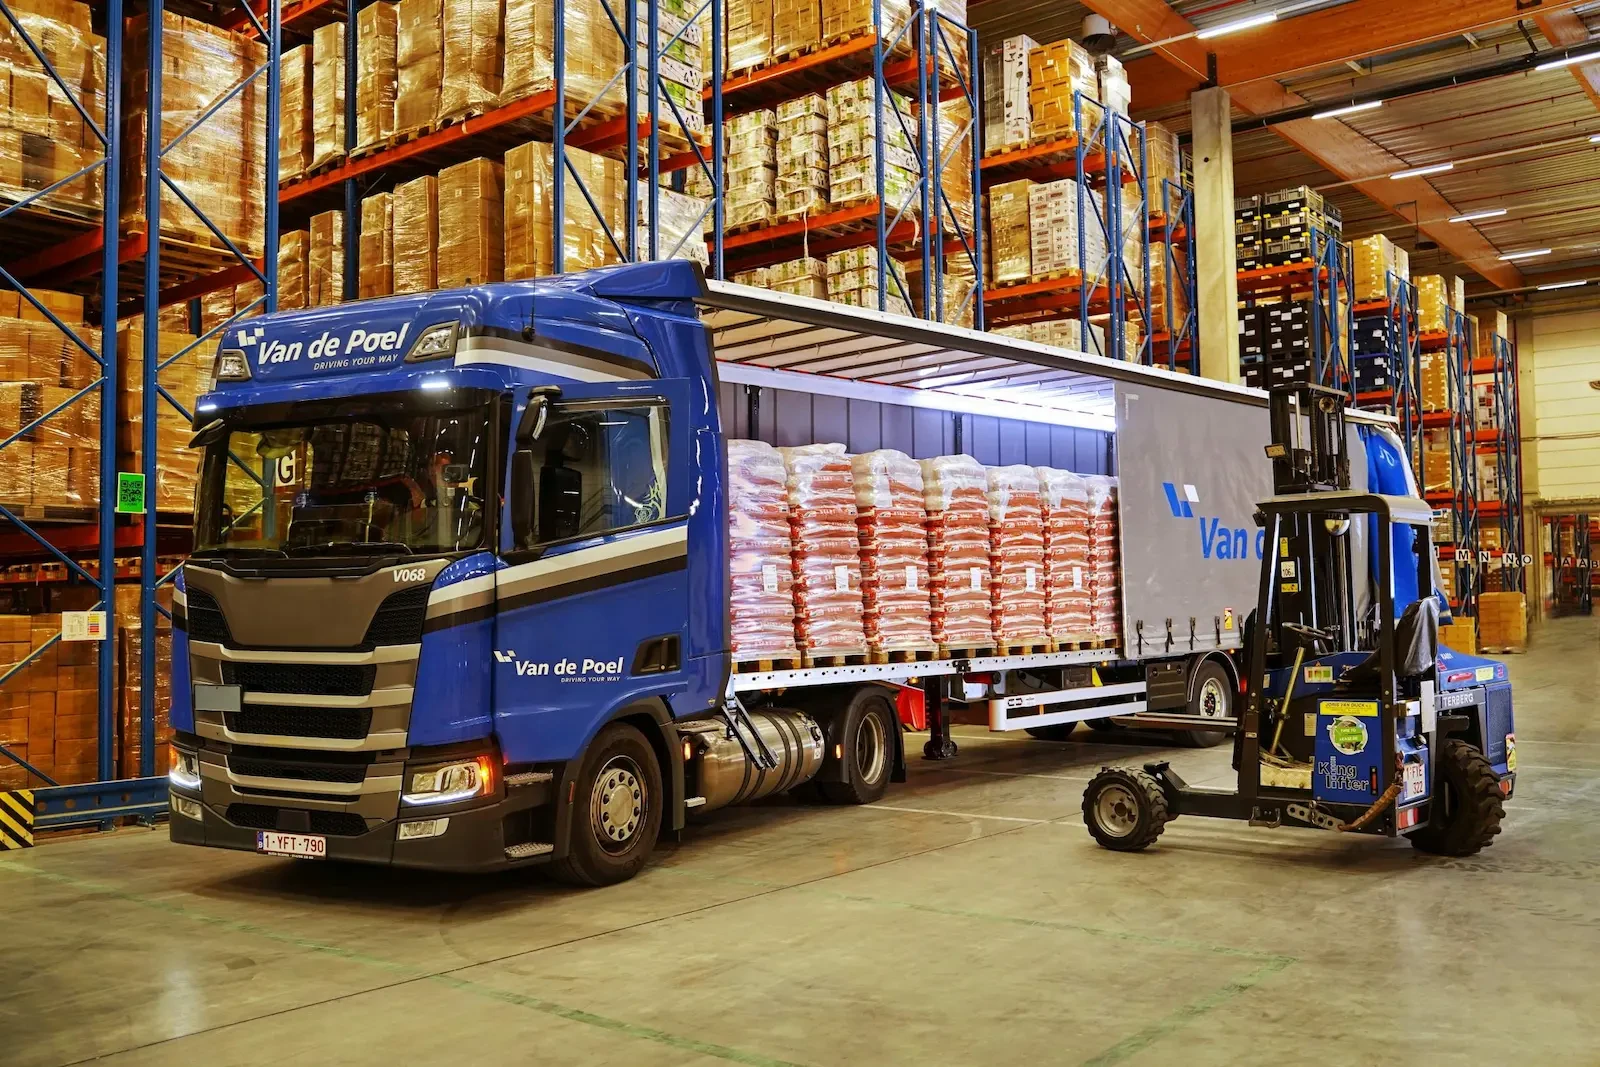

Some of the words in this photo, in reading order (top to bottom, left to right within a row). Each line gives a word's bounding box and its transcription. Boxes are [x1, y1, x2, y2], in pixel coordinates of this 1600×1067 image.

[258, 338, 303, 365] Van
[308, 332, 340, 359] de
[345, 323, 411, 355] Poel
[313, 359, 349, 371] DRIVING
[352, 357, 375, 367] YOUR
[378, 354, 398, 364] WAY
[278, 452, 293, 484] G
[1200, 517, 1248, 560] Van
[1458, 550, 1469, 560] M
[1480, 553, 1489, 562] N
[1505, 554, 1515, 563] N
[1523, 555, 1532, 564] O
[1562, 558, 1571, 566] A
[393, 568, 426, 582] V068
[515, 660, 549, 676] Van
[554, 658, 577, 675] de
[582, 656, 624, 674] Poel
[1442, 693, 1474, 707] TERBERG
